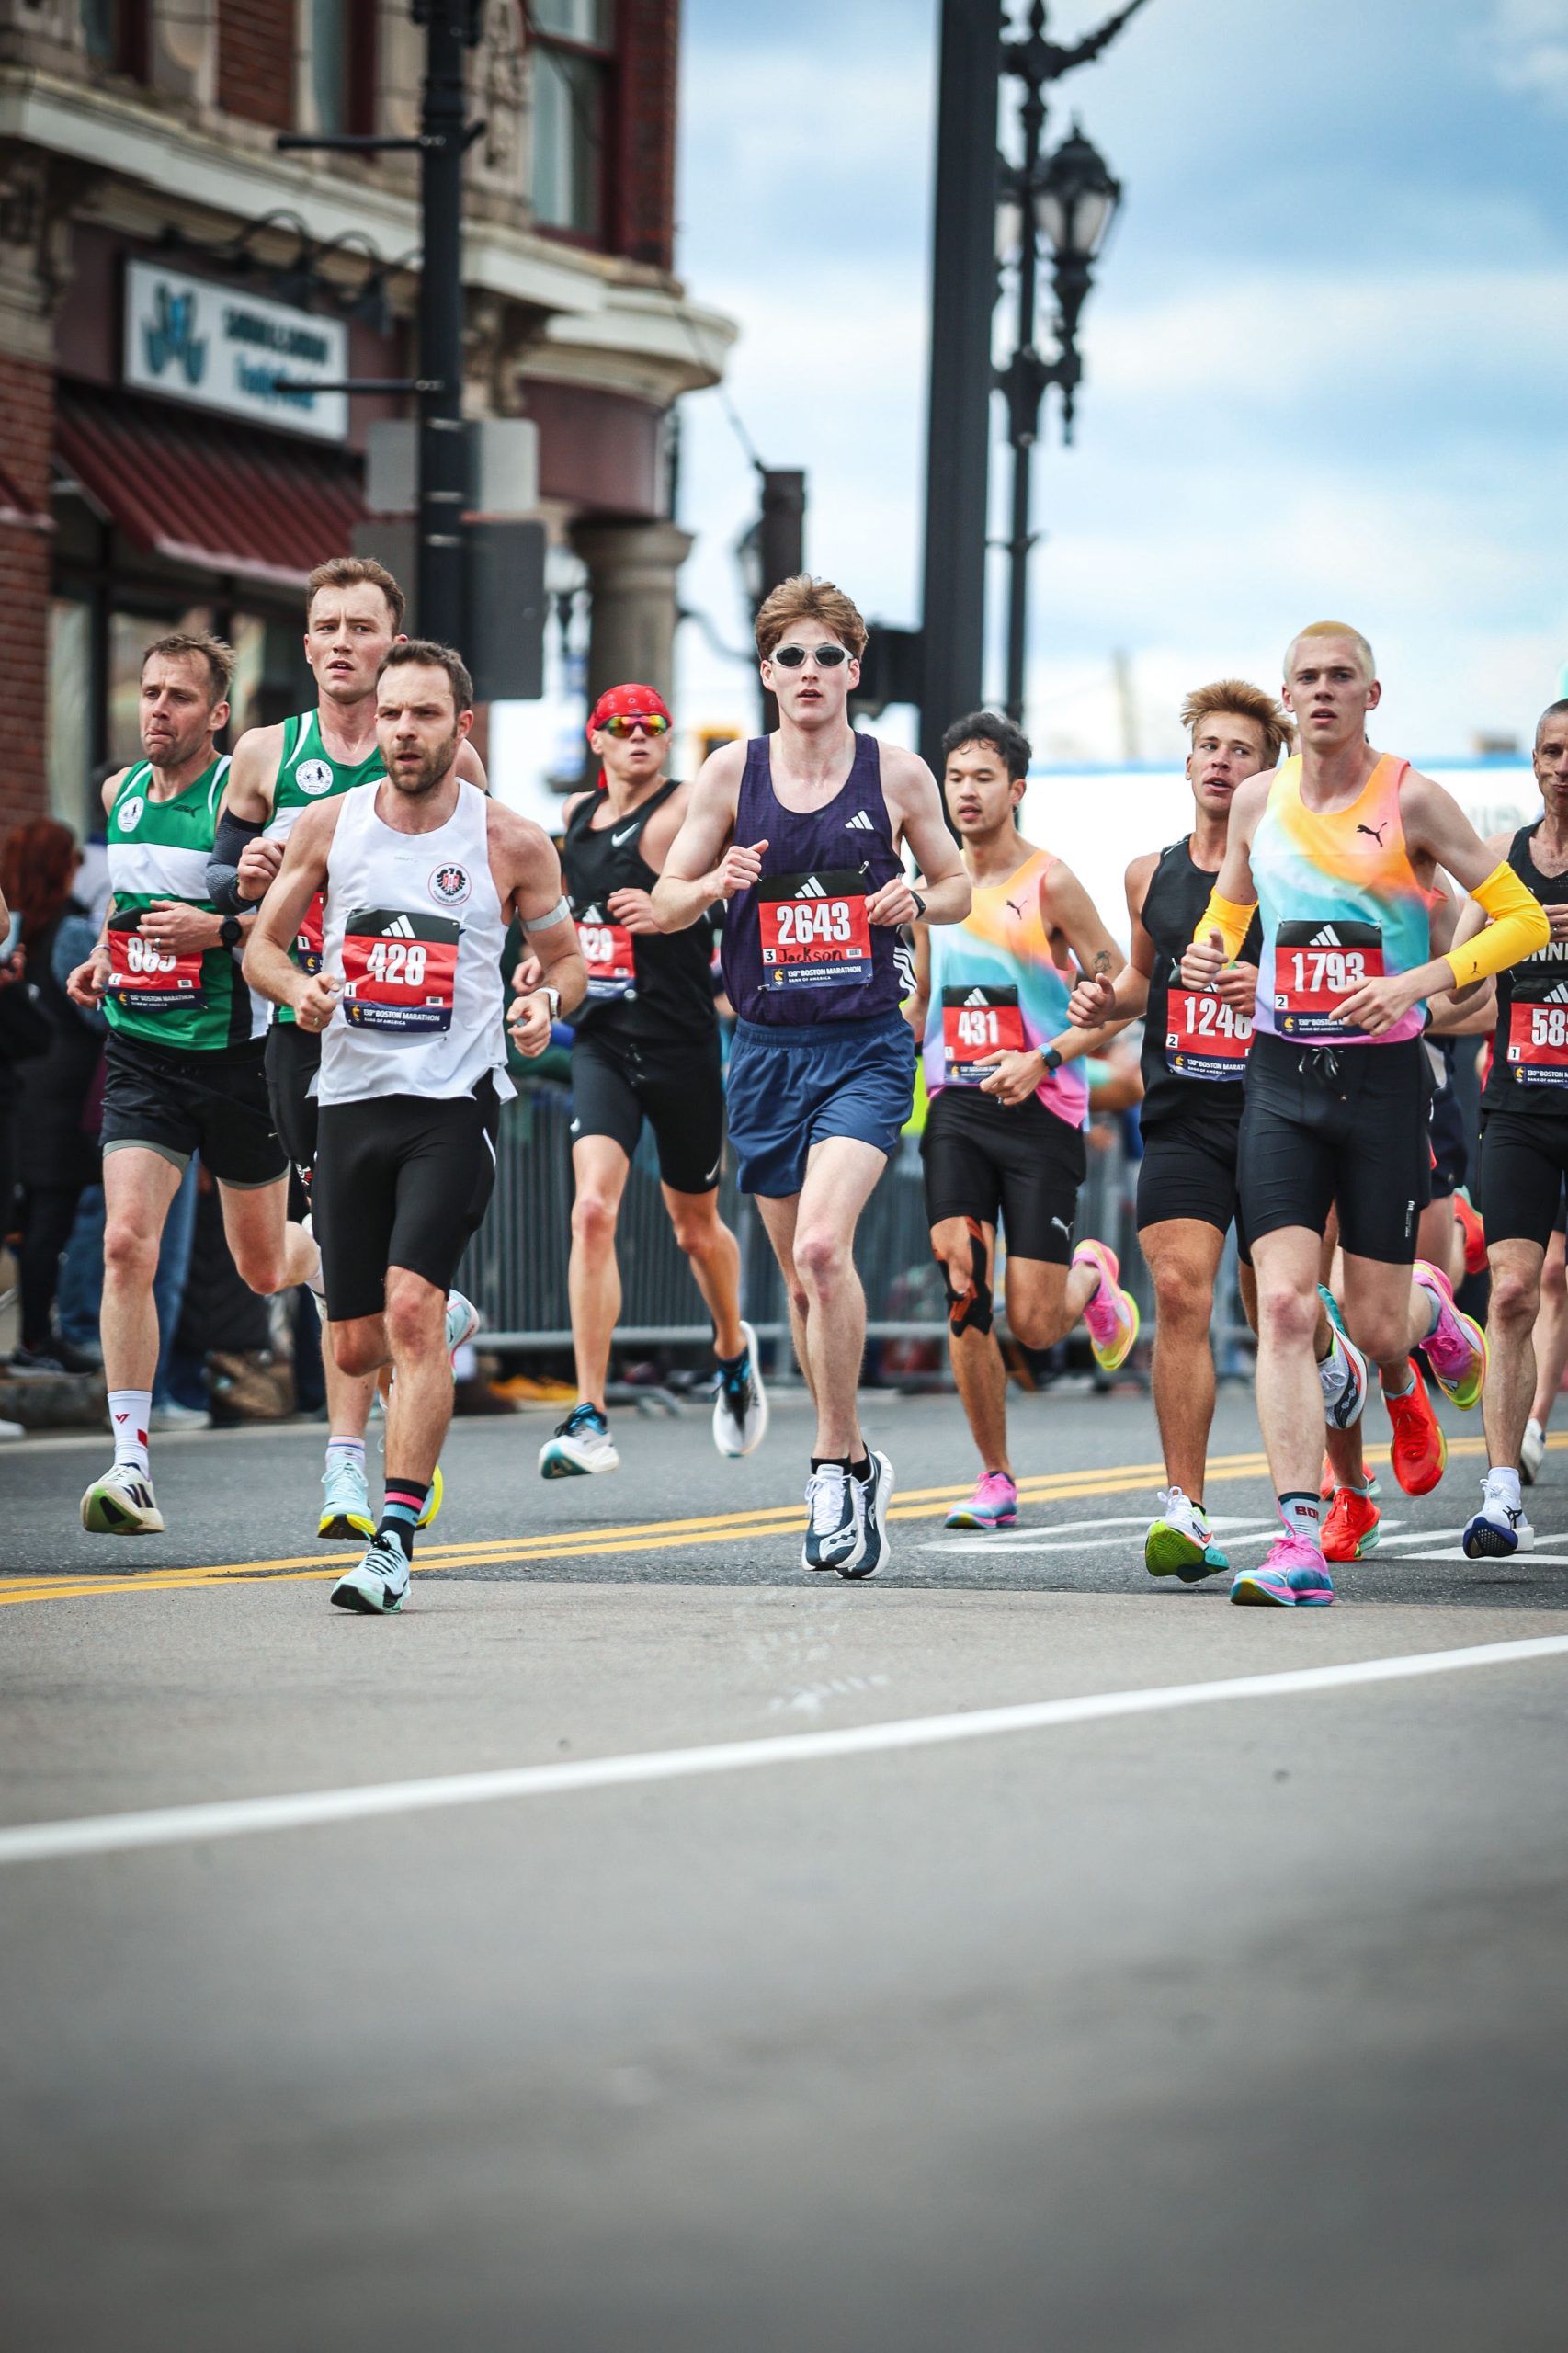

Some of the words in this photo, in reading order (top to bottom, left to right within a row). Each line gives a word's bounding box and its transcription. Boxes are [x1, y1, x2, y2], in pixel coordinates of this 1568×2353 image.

[777, 901, 851, 945] 2643
[766, 951, 774, 961] 3
[778, 947, 844, 963] Jackson
[366, 942, 427, 986] 428
[801, 968, 825, 976] BOSTON
[826, 966, 862, 974] MARATHON
[1290, 951, 1365, 995] 1793
[1278, 996, 1285, 1007] 2
[376, 1010, 402, 1019] BOSTON
[403, 1012, 441, 1022] MARATHON
[1184, 996, 1253, 1040] 1246
[958, 1010, 999, 1046] 431
[1531, 1008, 1568, 1047] 58
[1168, 1036, 1176, 1046] 2
[1199, 1060, 1222, 1069] BOSTON
[1540, 1070, 1564, 1078] BOSTON
